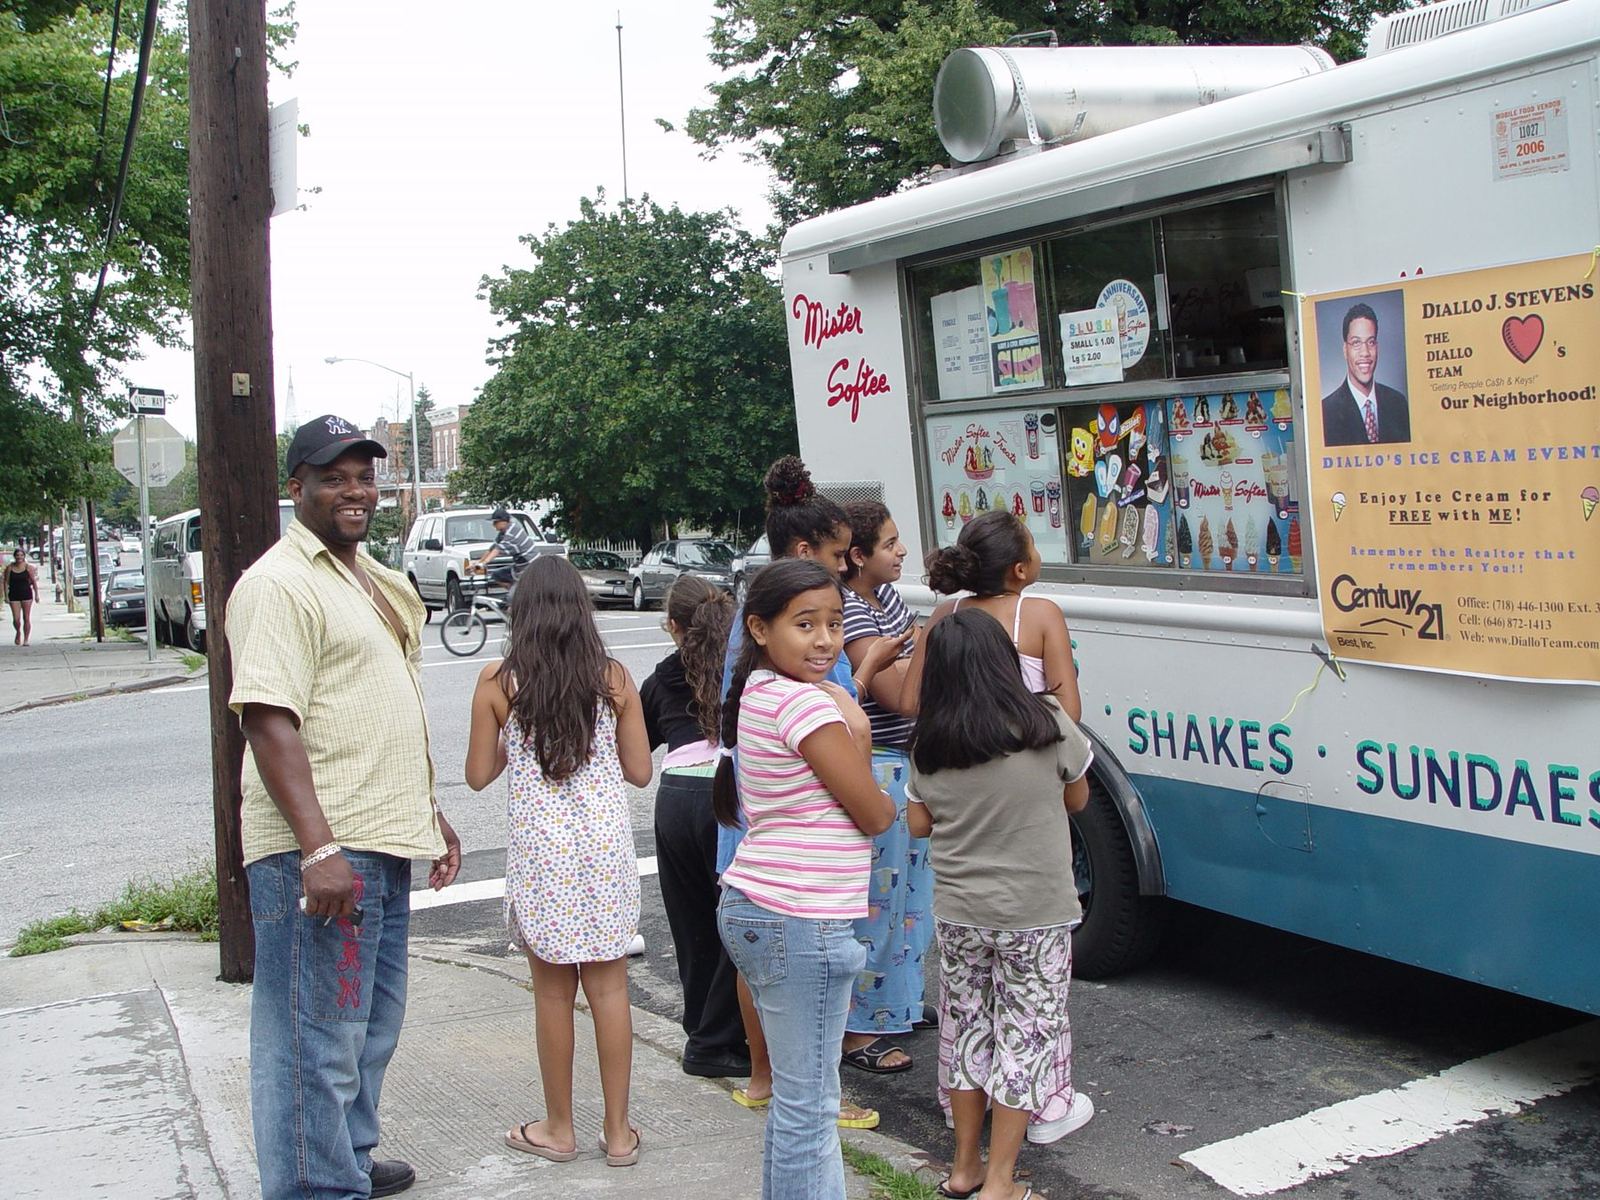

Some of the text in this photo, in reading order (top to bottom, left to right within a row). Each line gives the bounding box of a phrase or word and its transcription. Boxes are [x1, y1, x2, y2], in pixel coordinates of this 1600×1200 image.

[1519, 122, 1539, 139] 11027
[1516, 139, 1545, 157] 2006
[1102, 281, 1147, 314] ANNIVERSARY
[1486, 293, 1502, 311] J.
[1504, 283, 1594, 309] STEVENS
[793, 294, 864, 350] Mister
[1069, 319, 1112, 337] SLUSH
[1070, 339, 1094, 350] SMALL
[1101, 336, 1115, 345] 1.00
[1424, 331, 1450, 345] THE
[1087, 352, 1102, 361] 2.00
[1426, 347, 1473, 362] DIALLO
[1427, 365, 1463, 379] TEAM
[827, 357, 891, 423] Softee
[1458, 379, 1483, 391] People
[1507, 377, 1513, 385] &
[134, 395, 163, 407] ONE WAY
[1441, 385, 1597, 410] Our Neighborhood!
[941, 436, 965, 466] Mister
[965, 423, 991, 445] Softee
[1322, 444, 1600, 469] DIALLO'S ICE CREAM EVENT
[1189, 478, 1267, 504] Mister Softee
[1360, 489, 1552, 507] Enjoy Ice Cream for
[1389, 508, 1522, 524] FREE with ME!
[1351, 546, 1576, 560] Remember the Realtor that
[1389, 560, 1525, 574] remembers You!!
[1331, 573, 1444, 641] Century 21
[1457, 596, 1490, 610] Office:
[1492, 600, 1515, 612] (718)
[1517, 601, 1564, 613] 446-1300
[1567, 602, 1592, 613] Ext.
[1458, 613, 1552, 631] Cell: (646) 872-1413
[1460, 630, 1600, 650] Web: www.DialloTeam.com
[1127, 707, 1294, 775] SHAKES
